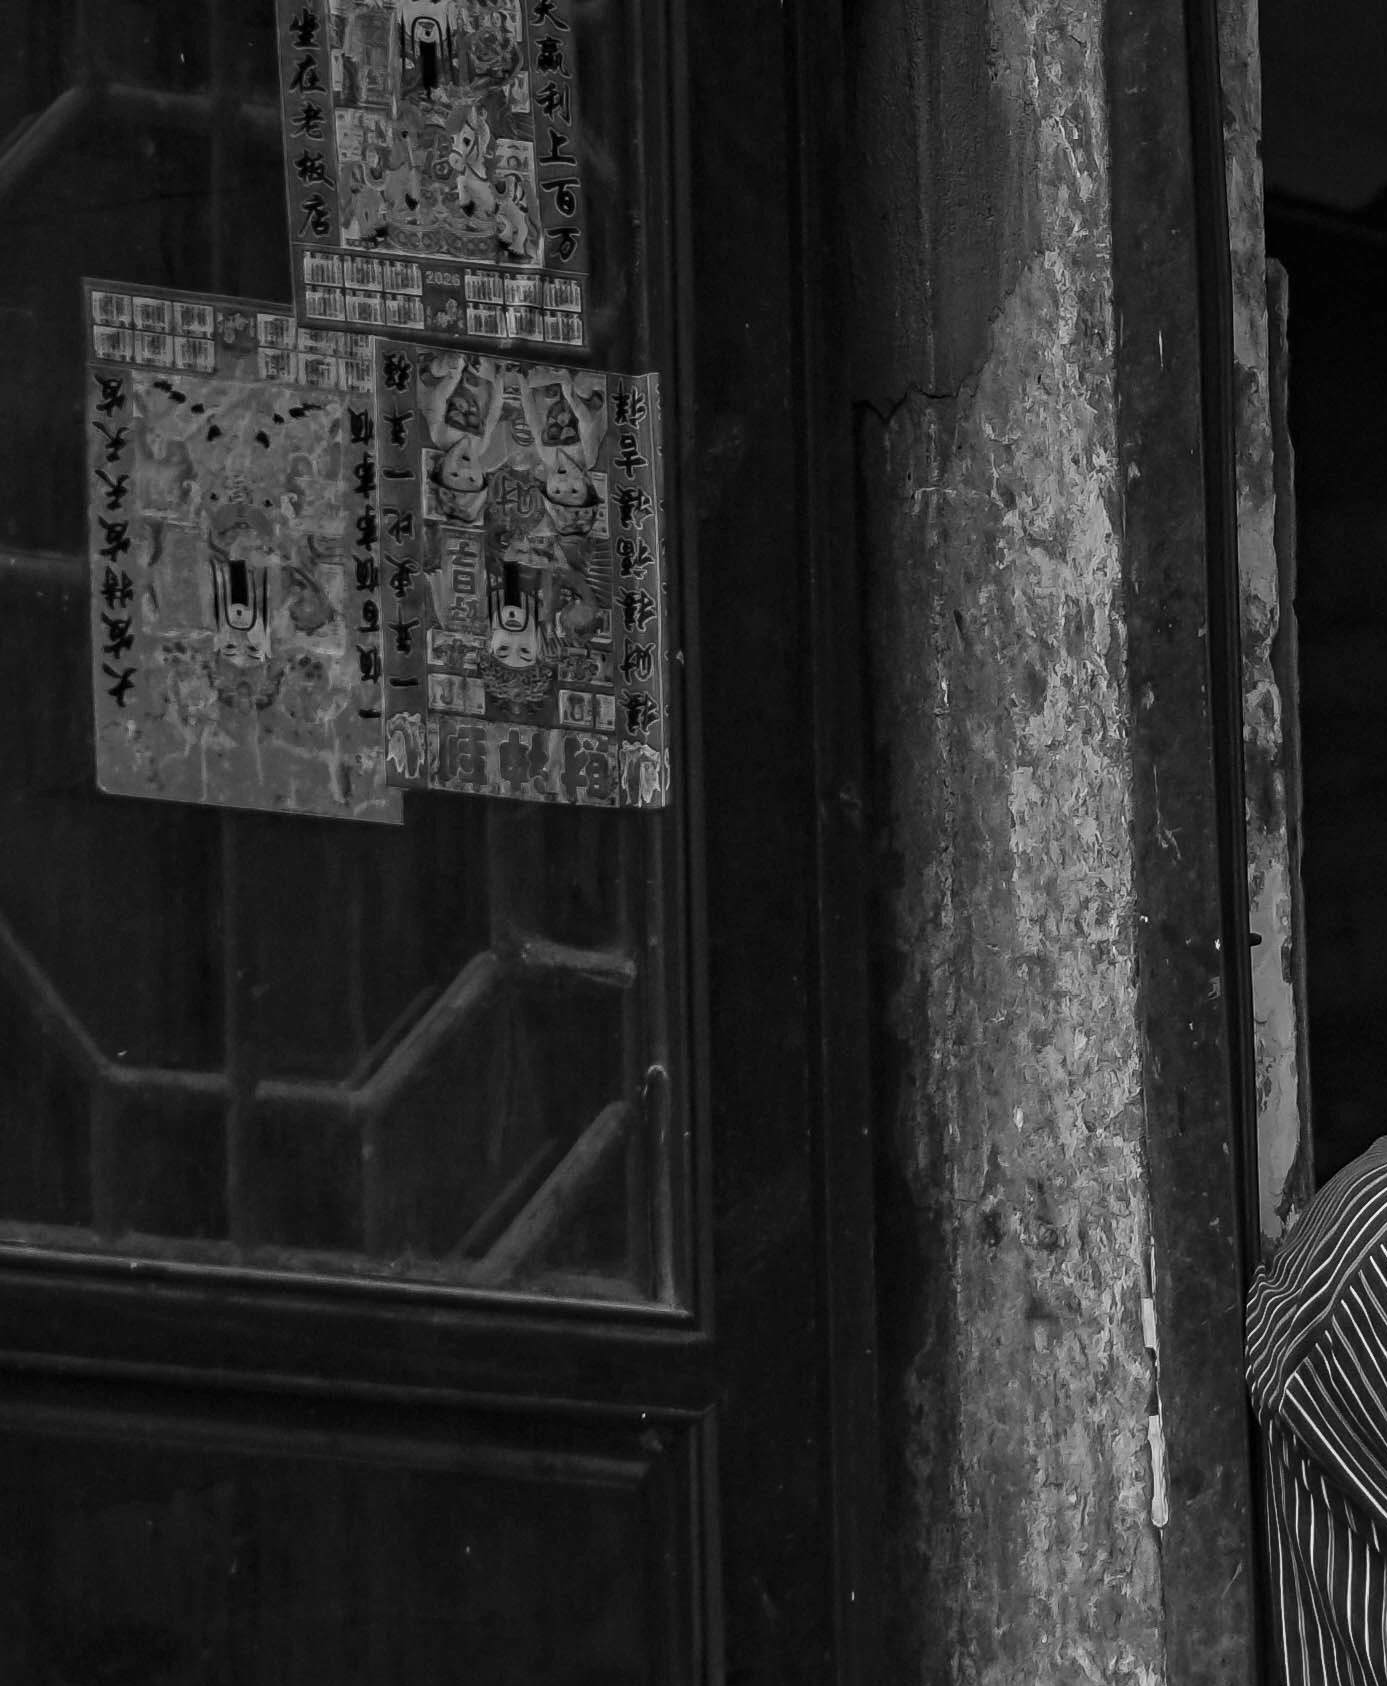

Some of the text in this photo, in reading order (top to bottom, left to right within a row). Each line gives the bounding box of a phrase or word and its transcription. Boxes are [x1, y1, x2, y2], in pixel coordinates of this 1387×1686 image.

[289, 0, 334, 236] 坐在老板店
[425, 270, 460, 286] 2026
[94, 373, 138, 708] 大发特发天天发
[348, 407, 384, 719] 一顺百顺事事顺
[383, 352, 420, 688] 一年更比一年强
[613, 378, 657, 739] 接财接福接吉祥
